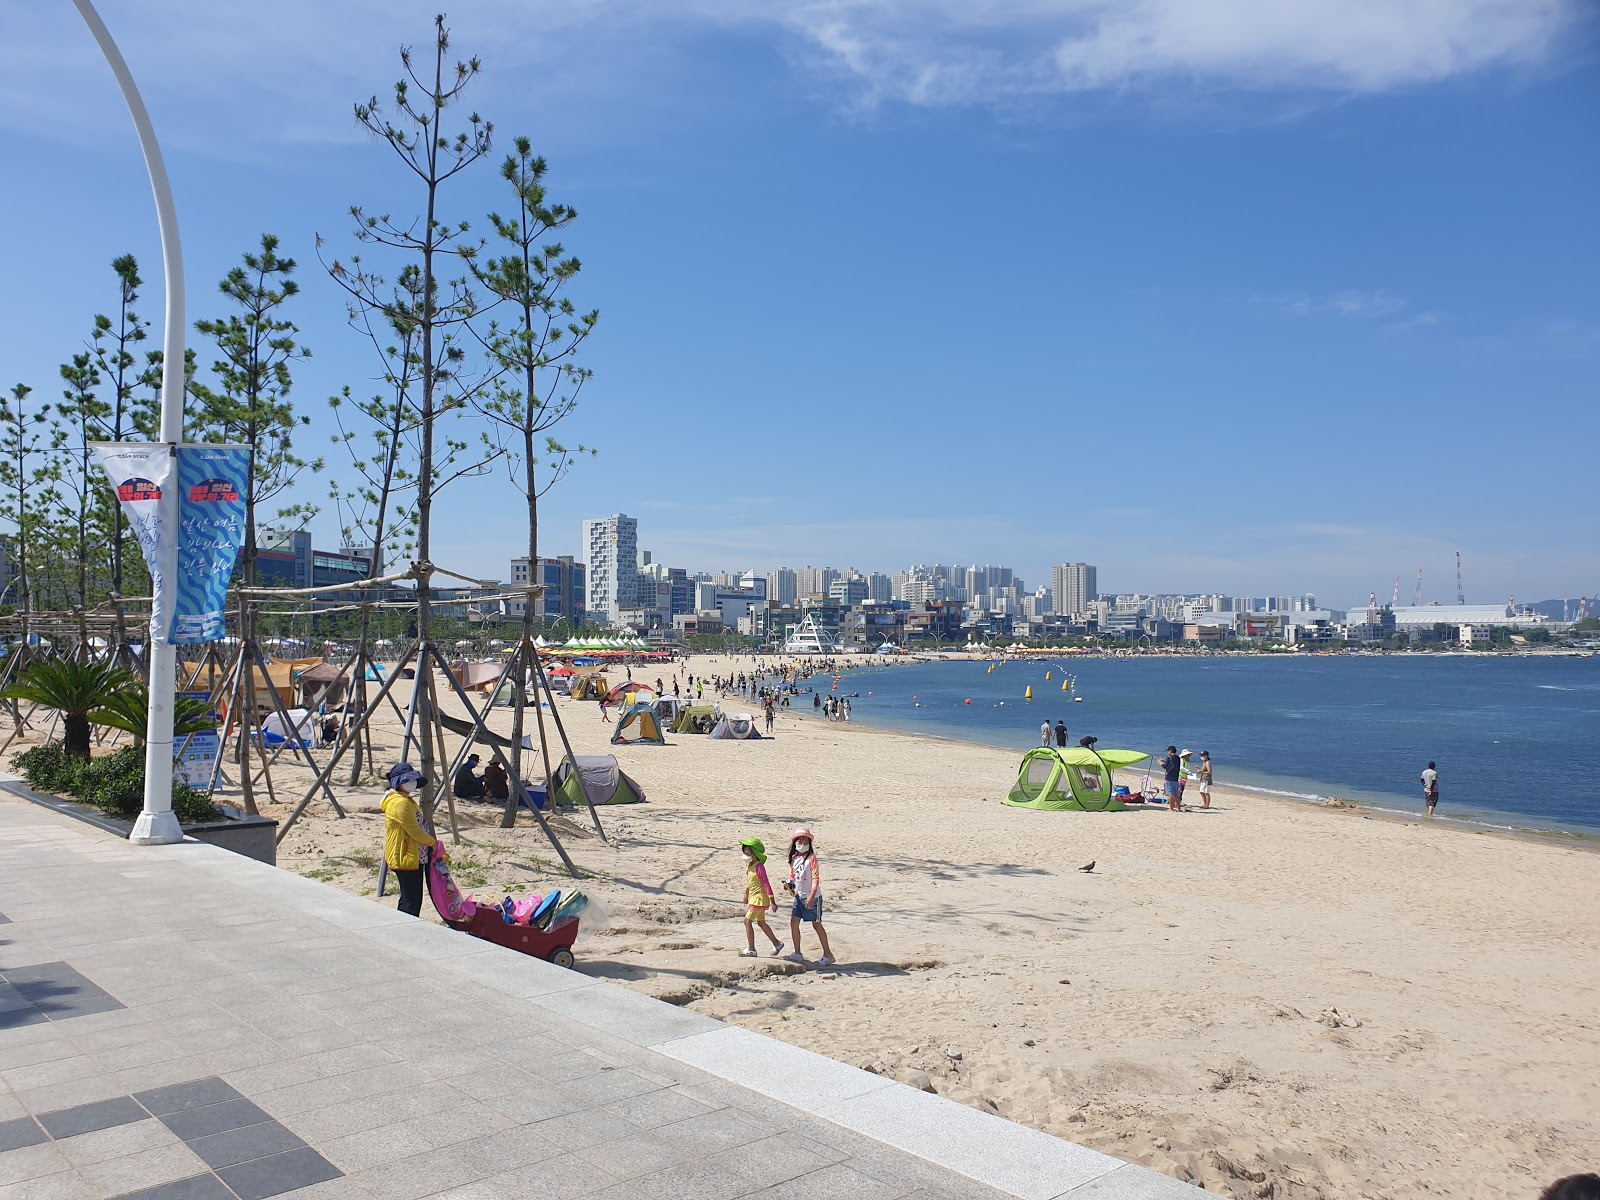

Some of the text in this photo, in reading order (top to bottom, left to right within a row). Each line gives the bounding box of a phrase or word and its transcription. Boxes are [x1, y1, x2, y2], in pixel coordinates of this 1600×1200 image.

[136, 482, 157, 492] 일산
[211, 483, 233, 493] 일산
[182, 517, 211, 535] 일산
[213, 514, 238, 532] 여름
